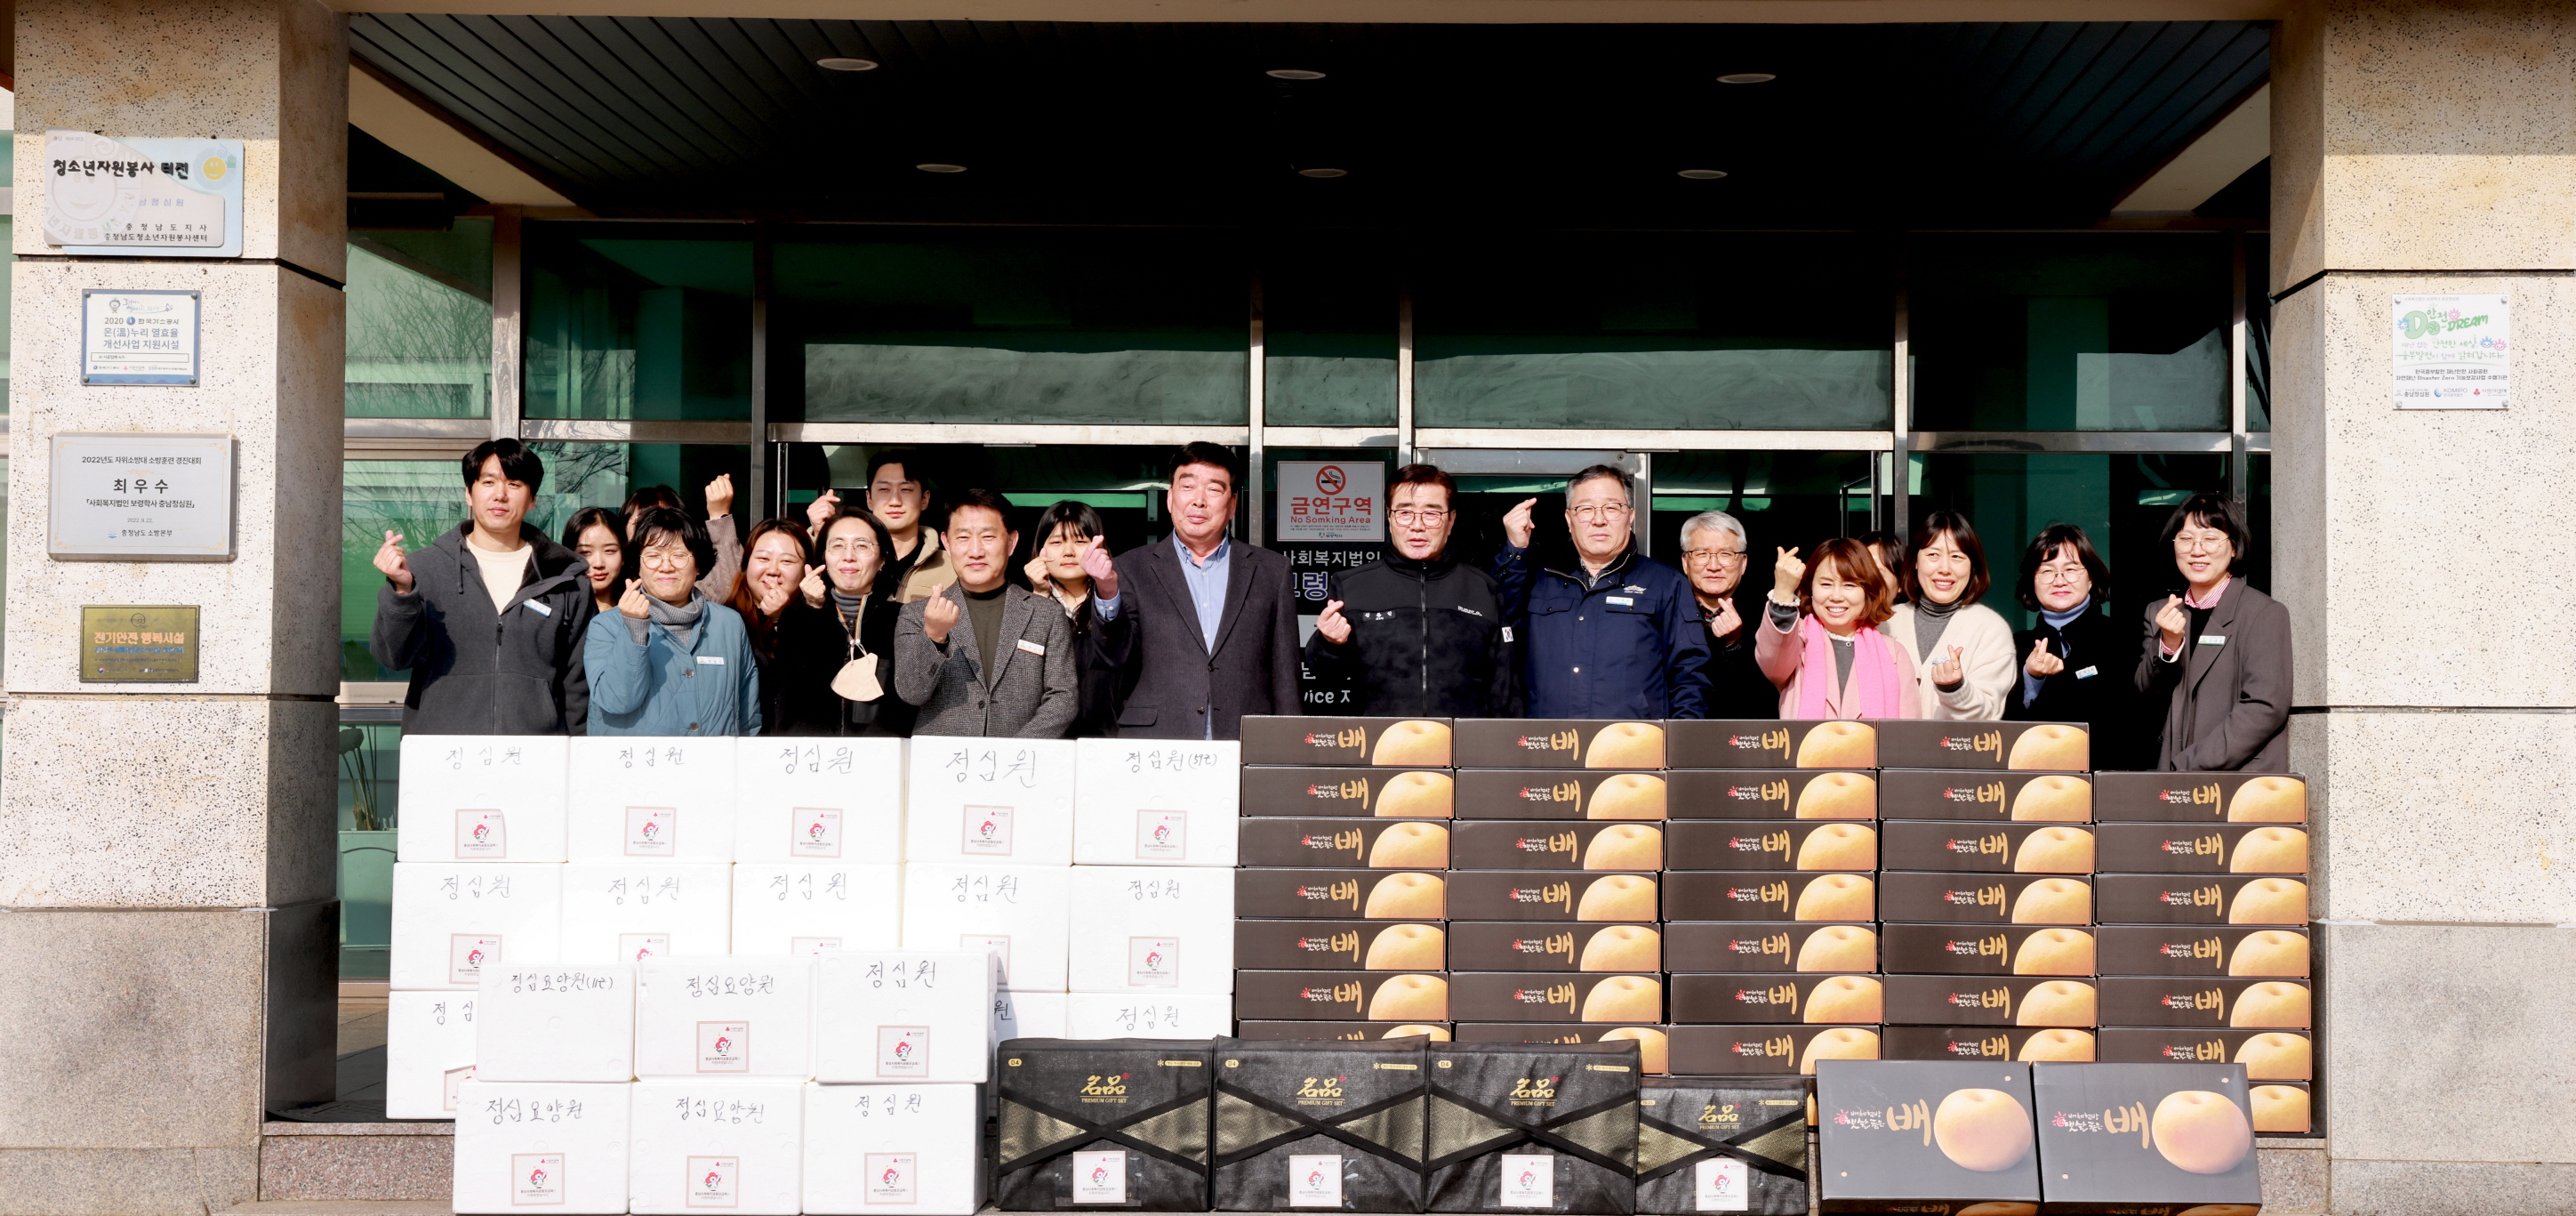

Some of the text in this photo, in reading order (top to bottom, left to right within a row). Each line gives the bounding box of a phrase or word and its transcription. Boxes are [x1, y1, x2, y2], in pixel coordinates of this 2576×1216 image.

[52, 159, 155, 178] 청소년자원봉사
[104, 233, 207, 242] 충청남도청소년자원봉사센터
[2427, 308, 2448, 322] 안전
[103, 327, 179, 338] 온(溫)누리 열효율
[103, 340, 179, 350] 개선사업 지원시설
[82, 456, 202, 465] 2022년도 자위소방대 소방훈련 경진대회
[130, 499, 157, 508] 보령학사
[1290, 496, 1371, 515] 금연구역
[148, 529, 173, 537] 소방본부
[1290, 516, 1371, 525] No Somking Area
[94, 632, 185, 644] 전기안전 행복시설
[1338, 726, 1366, 758] 배
[1551, 729, 1579, 761] 배
[1761, 728, 1790, 760] 배
[1974, 729, 2002, 762] 배
[1341, 777, 1369, 809] 배
[1553, 780, 1581, 812] 배
[1761, 778, 1790, 810] 배
[1977, 781, 2005, 813] 배
[2193, 783, 2221, 815] 배
[1335, 828, 1363, 860] 배
[1549, 830, 1577, 863] 배
[1762, 830, 1790, 862] 배
[1979, 832, 2008, 865] 배
[2195, 833, 2224, 866] 배
[1330, 879, 1359, 912] 배
[1543, 881, 1571, 914] 배
[1761, 880, 1789, 913] 배
[1978, 883, 2006, 916] 배
[2194, 884, 2222, 917] 배
[1331, 930, 1360, 962] 배
[1545, 931, 1574, 964] 배
[1761, 932, 1790, 965] 배
[1979, 933, 2008, 966] 배
[2194, 937, 2222, 970] 배
[1334, 980, 1362, 1013] 배
[1547, 982, 1576, 1015] 배
[1769, 982, 1797, 1015] 배
[1982, 986, 2010, 1019] 배
[2195, 987, 2224, 1020] 배
[1765, 1035, 1794, 1067] 배
[1080, 1075, 1127, 1095] 名品
[1297, 1077, 1343, 1098] 名品
[1510, 1078, 1555, 1099] 名品
[1698, 1104, 1739, 1123] 名品
[1886, 1099, 1931, 1147] 배
[2104, 1101, 2150, 1149] 배
